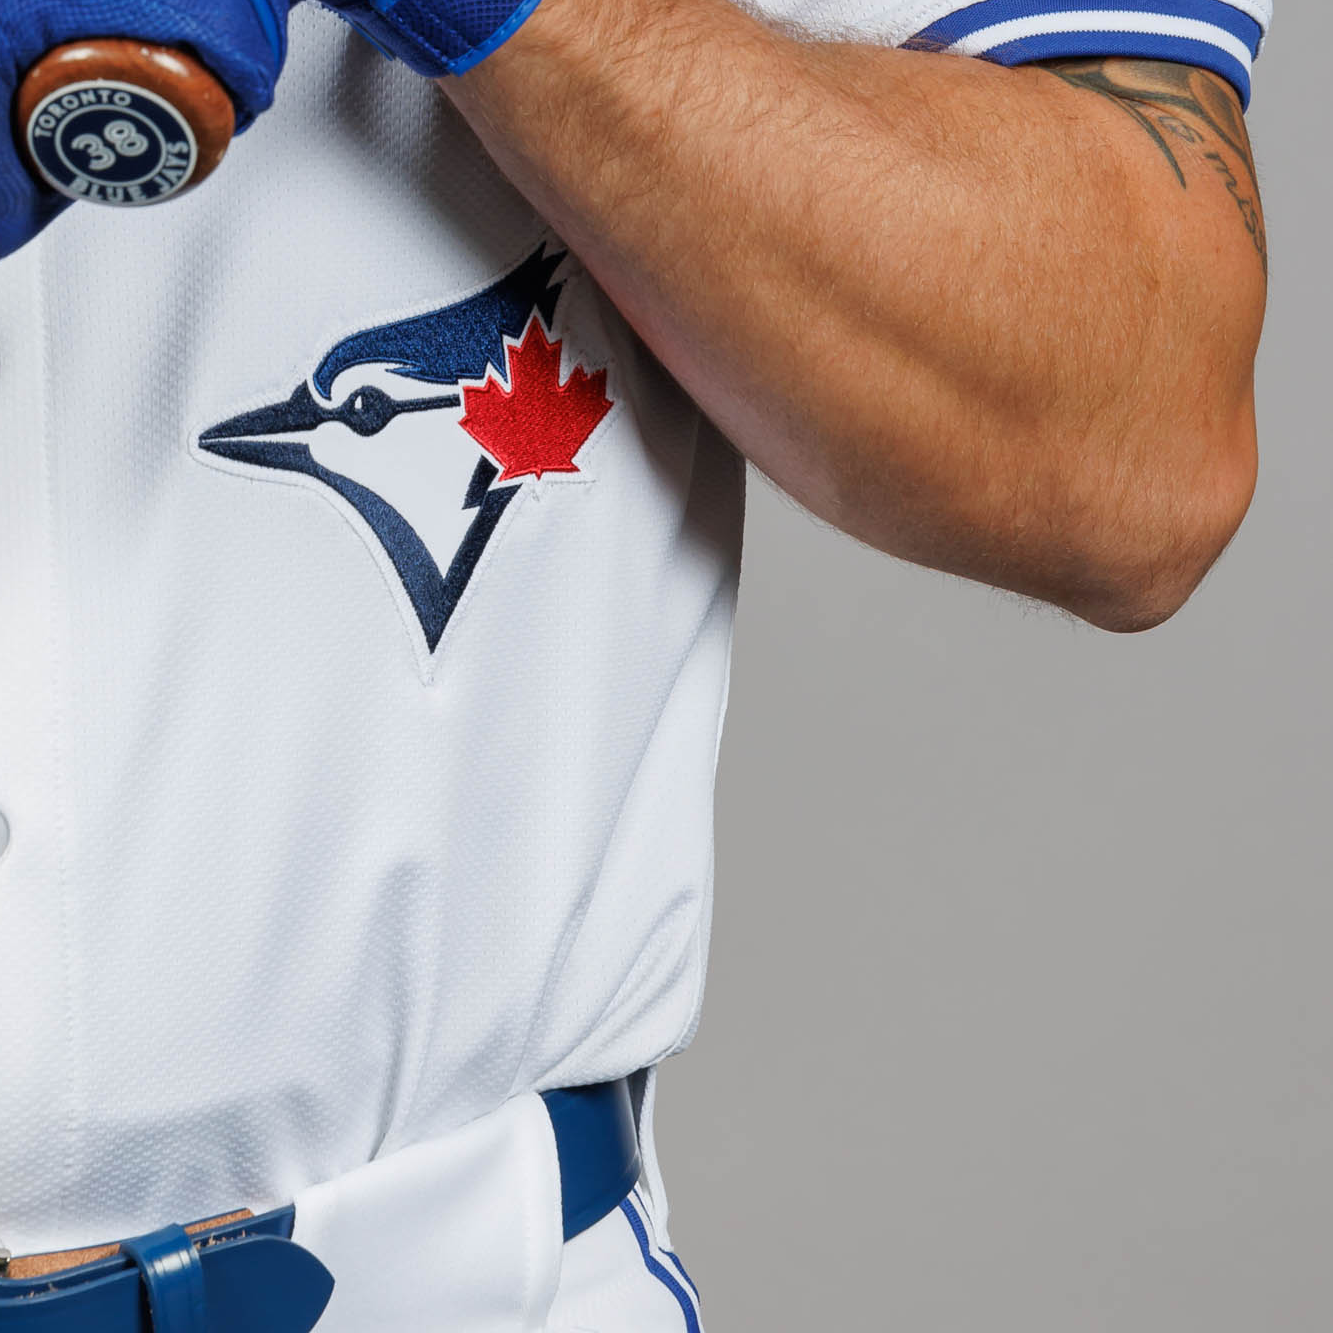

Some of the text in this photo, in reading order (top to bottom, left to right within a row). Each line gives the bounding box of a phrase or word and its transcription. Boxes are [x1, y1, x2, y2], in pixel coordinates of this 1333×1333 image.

[33, 89, 132, 138] TORONTO
[67, 140, 190, 202] BLUE JAYS
[71, 119, 149, 171] 38
